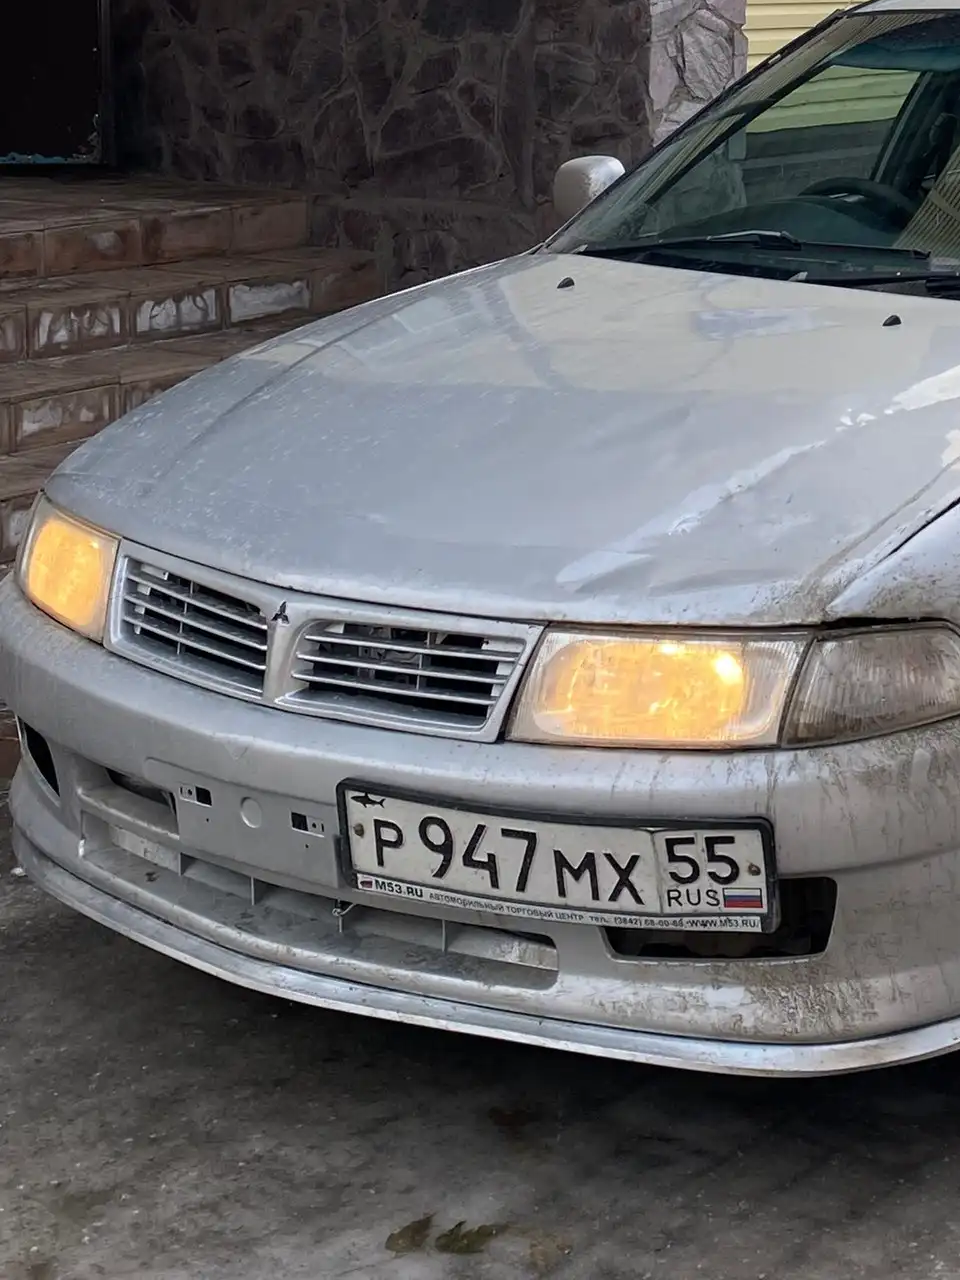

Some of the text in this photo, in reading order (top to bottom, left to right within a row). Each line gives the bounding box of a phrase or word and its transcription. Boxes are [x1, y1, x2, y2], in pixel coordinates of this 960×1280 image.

[664, 835, 740, 885] 55
[375, 879, 424, 898] M53.RU
[429, 892, 504, 911] АВТОМОБИЛЬНЫЙ
[506, 905, 552, 919] ТОРГОВЫЙ
[556, 912, 583, 921] ЦЕНТР
[666, 888, 720, 907] RUS
